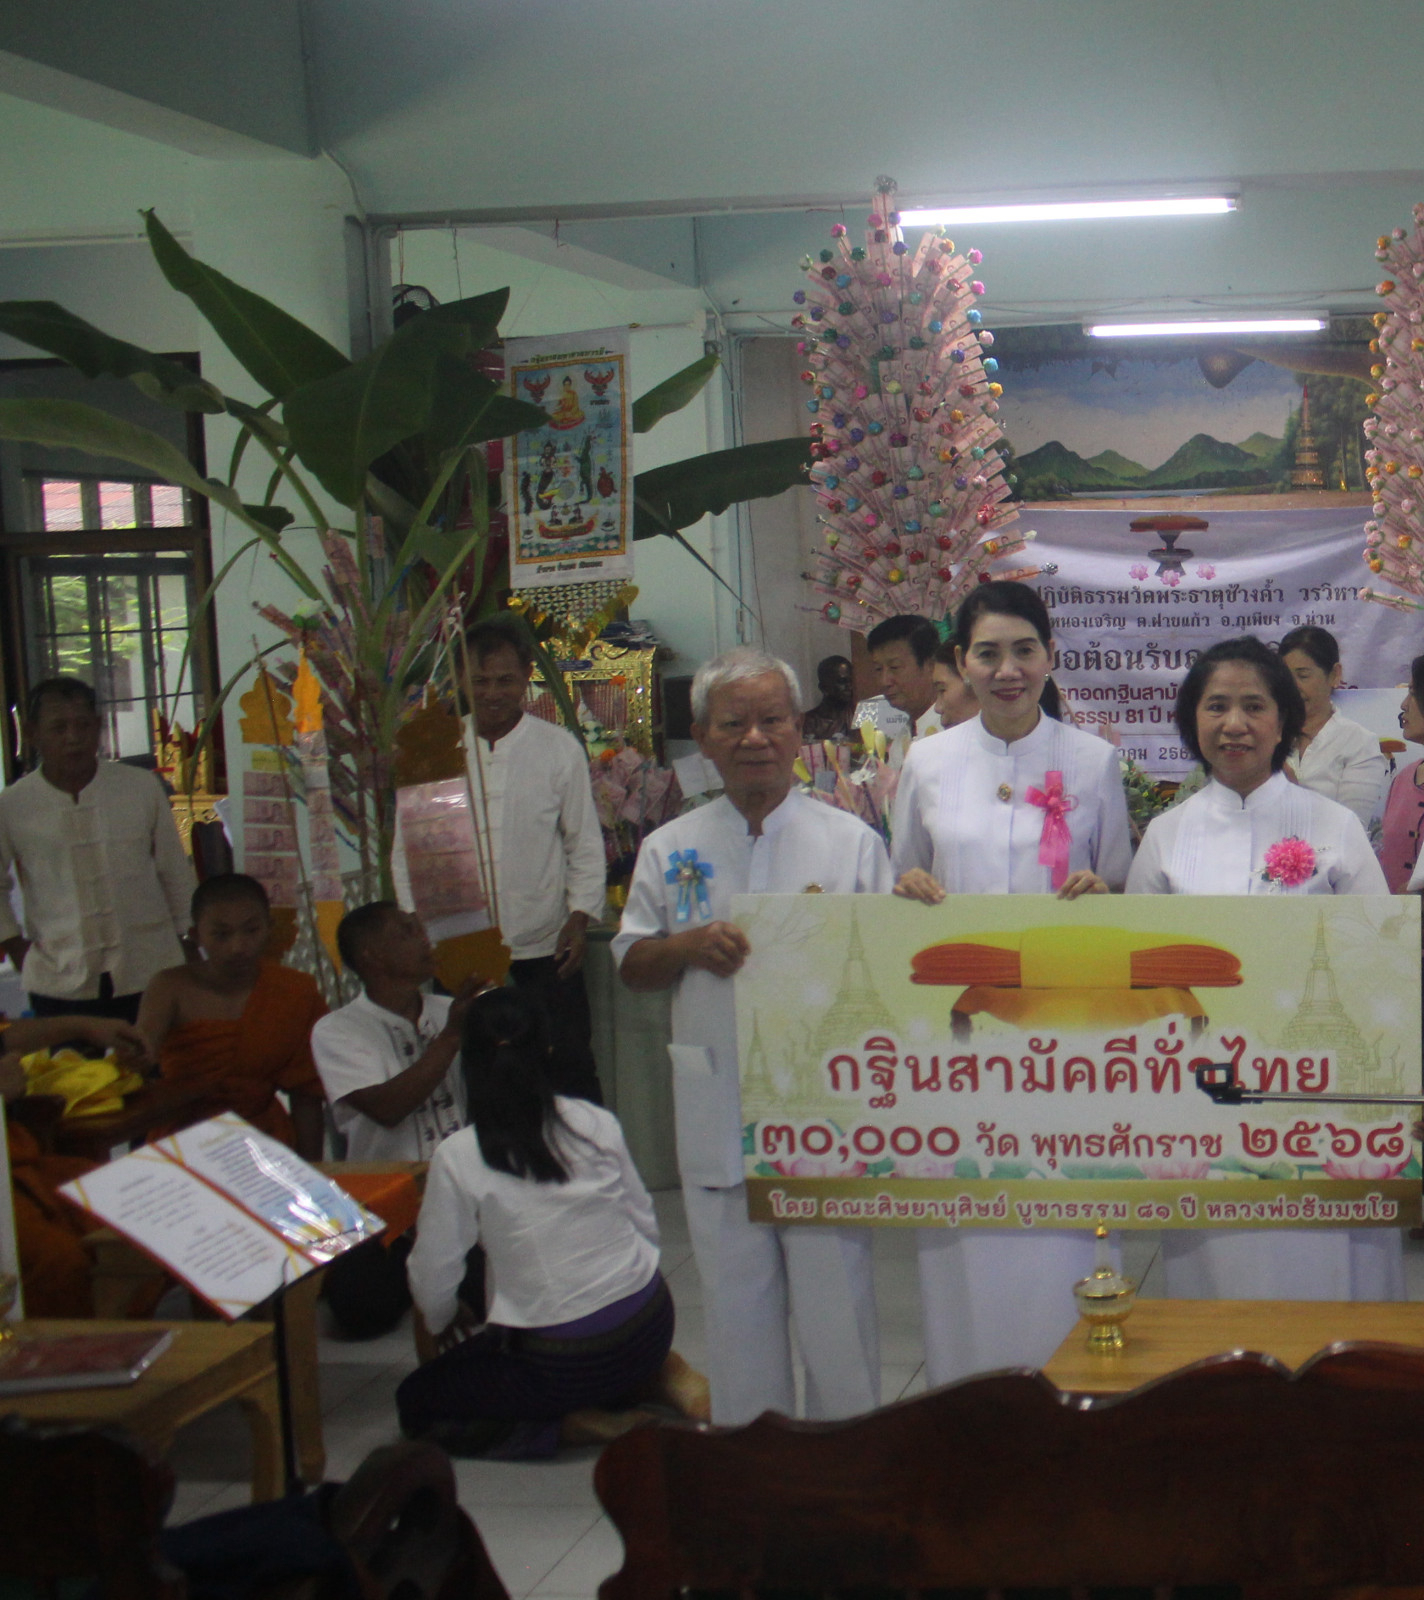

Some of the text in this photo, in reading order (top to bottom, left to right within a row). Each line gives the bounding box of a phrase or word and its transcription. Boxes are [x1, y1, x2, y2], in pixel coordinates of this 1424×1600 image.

[1299, 582, 1365, 602] วรวิหา
[1125, 708, 1144, 724] 81
[1148, 704, 1162, 724] ปี
[1158, 747, 1192, 761] 256
[827, 1021, 1330, 1109] กฐินสามัคคีทั่วไทย
[762, 1120, 1405, 1170] ๓๐,๐๐๐ วัด พุทธศักราช ๒๕๖๘
[770, 1191, 1397, 1225] โดย คณะศิษยานุศิษย์ บูชาธรรม ๘๑ ปี หลวงพ่อธัมมชโย
